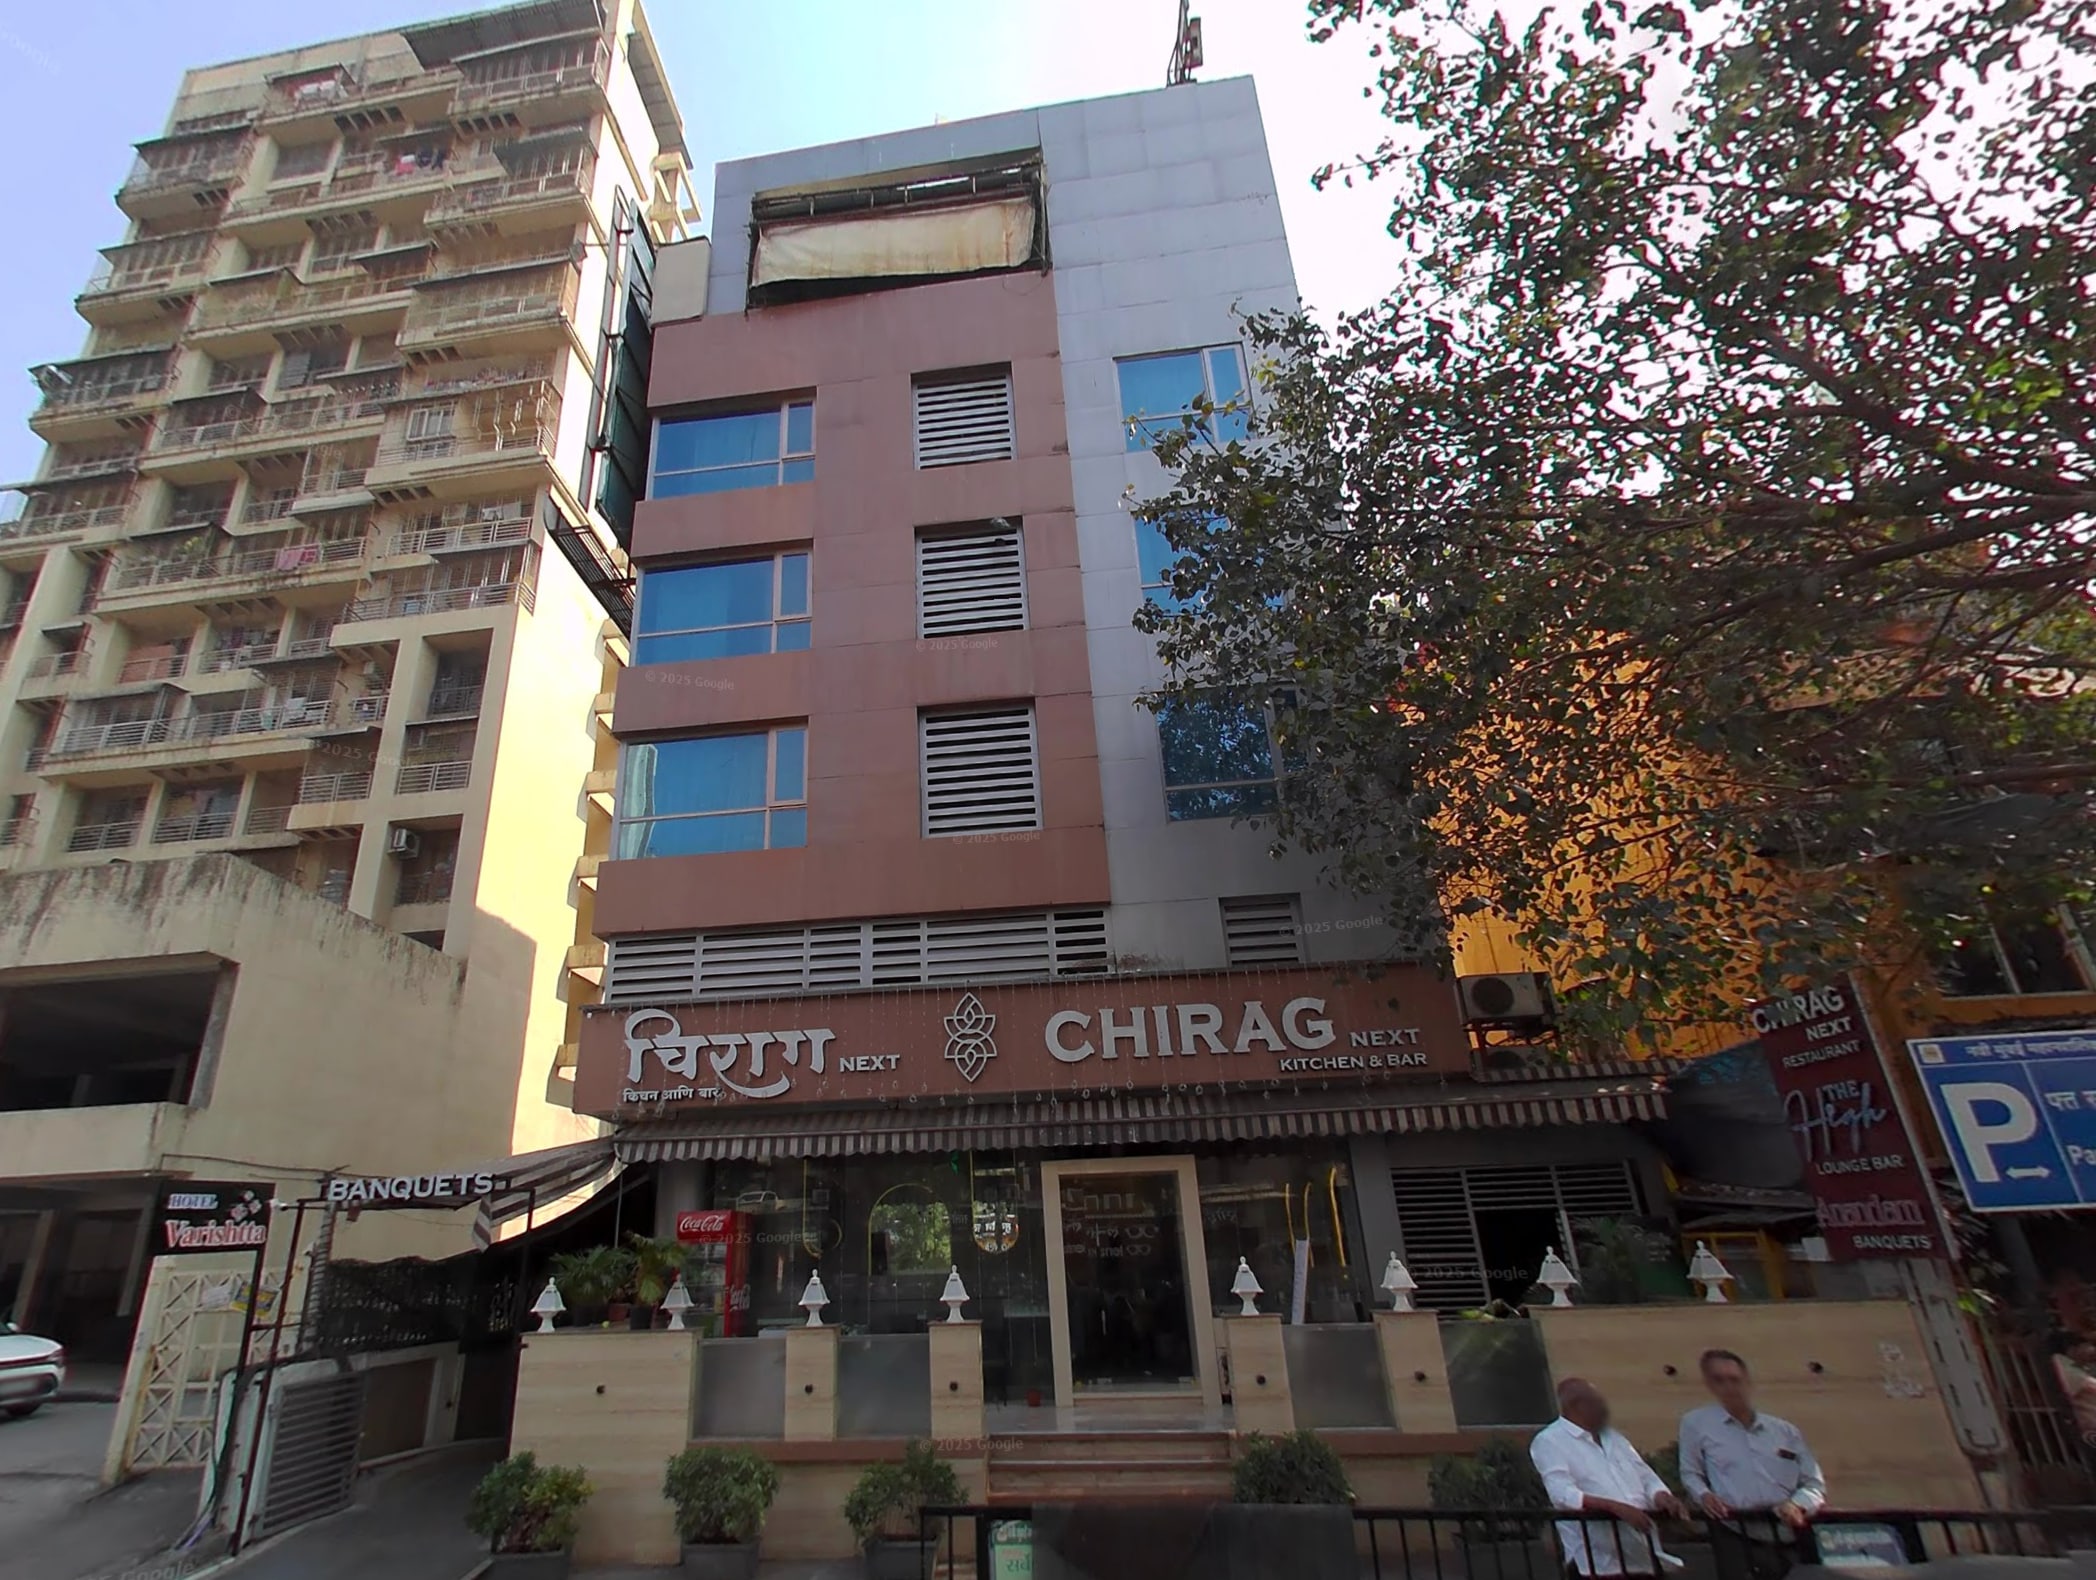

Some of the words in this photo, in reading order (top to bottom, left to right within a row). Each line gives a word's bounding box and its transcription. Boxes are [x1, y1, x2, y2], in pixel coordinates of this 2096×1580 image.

[1045, 997, 1336, 1063] CHIRAG
[1350, 1028, 1420, 1047] NEXT
[1805, 1017, 1851, 1041] NEXT
[624, 1008, 836, 1098] चिराग
[839, 1054, 900, 1073] NEXT
[1280, 1056, 1364, 1071] KITCHEN
[1369, 1055, 1382, 1067] &
[1387, 1052, 1427, 1066] BAR
[1782, 1039, 1861, 1069] RESTAURANT
[1824, 1080, 1860, 1099] THE
[1939, 1082, 2038, 1183] P
[1815, 1159, 1871, 1175] LOUNGE
[1872, 1154, 1904, 1170] BAR
[326, 1172, 495, 1201] BANQUETS
[168, 1193, 218, 1209] HOTEL
[1853, 1235, 1933, 1250] BANQUETS
